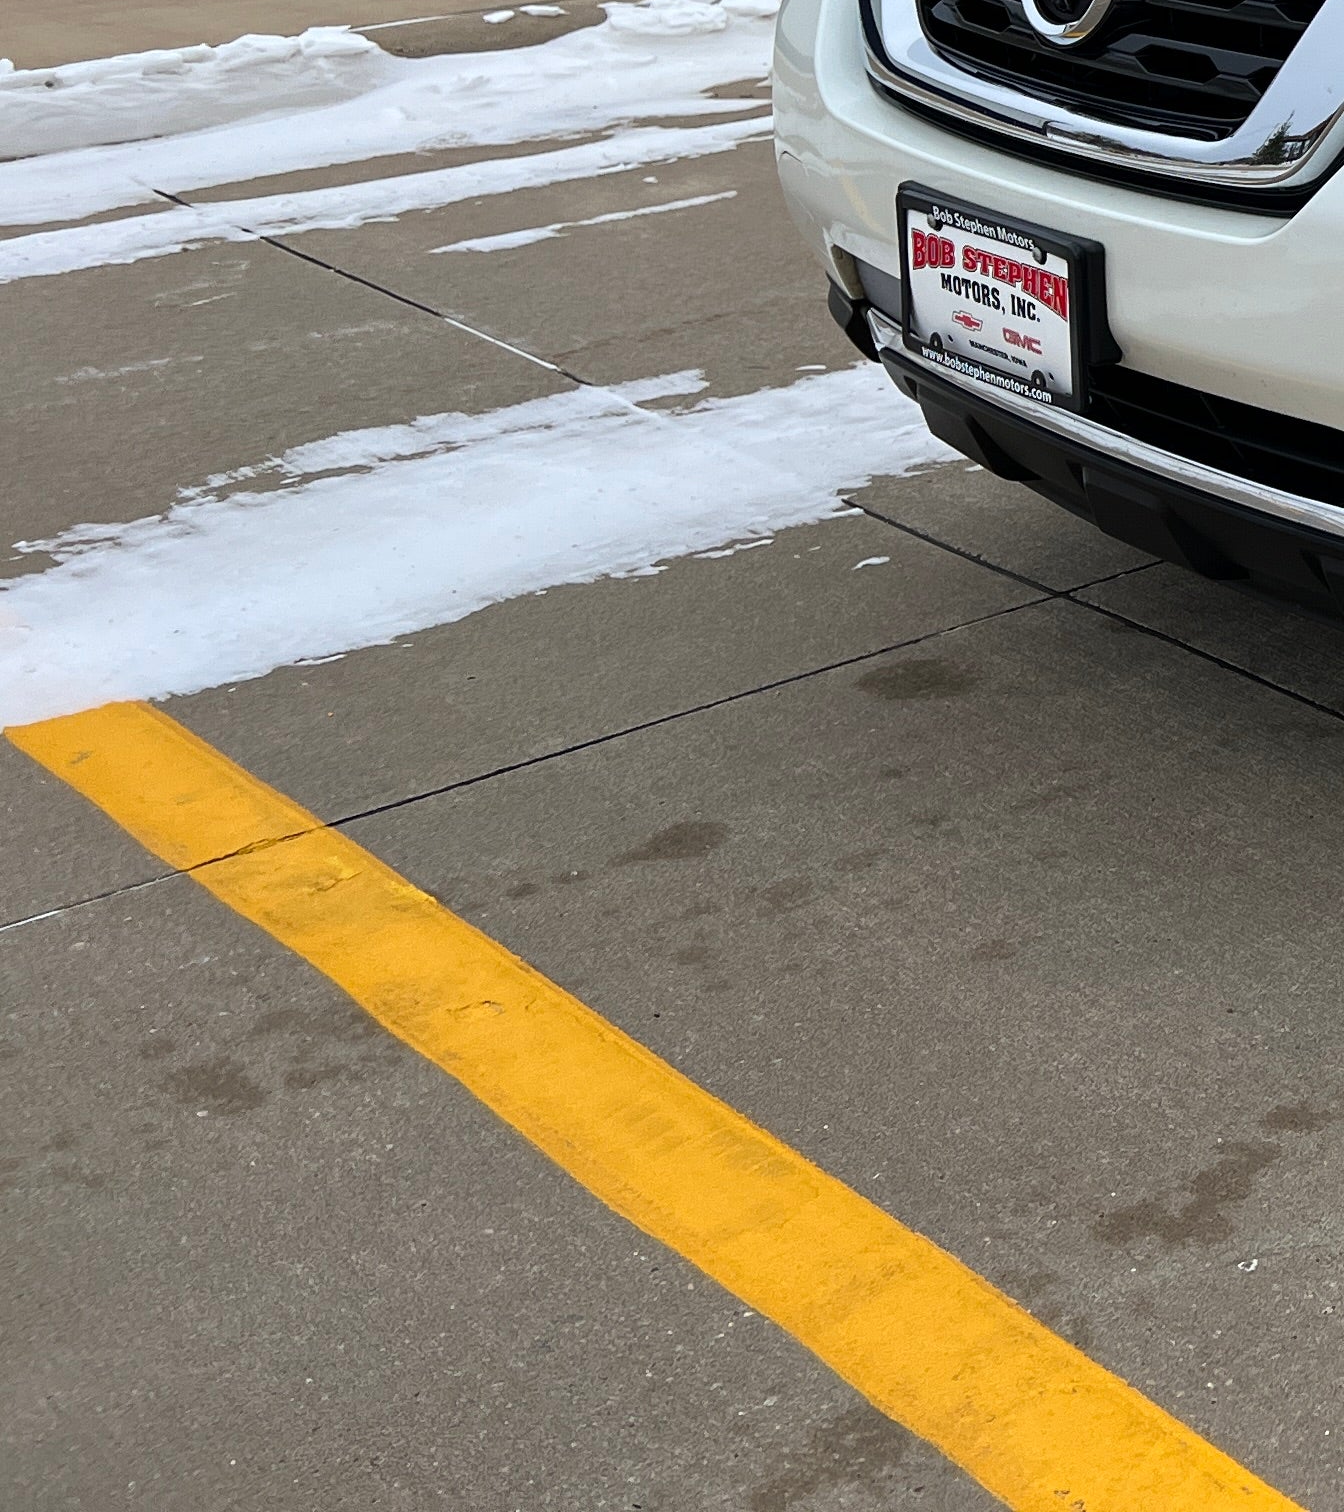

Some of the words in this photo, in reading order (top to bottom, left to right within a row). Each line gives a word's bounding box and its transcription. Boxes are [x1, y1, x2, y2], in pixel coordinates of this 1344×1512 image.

[932, 205, 954, 224] Bob
[954, 212, 996, 239] Stephen
[996, 225, 1035, 250] Motors
[911, 228, 956, 270] BOB
[962, 245, 1069, 322] STEPHEN
[940, 273, 1006, 316] MOTORS,
[1010, 293, 1041, 323] INC.
[1002, 327, 1043, 355] GMC
[921, 346, 1052, 404] www.bobstephenmotors.com
